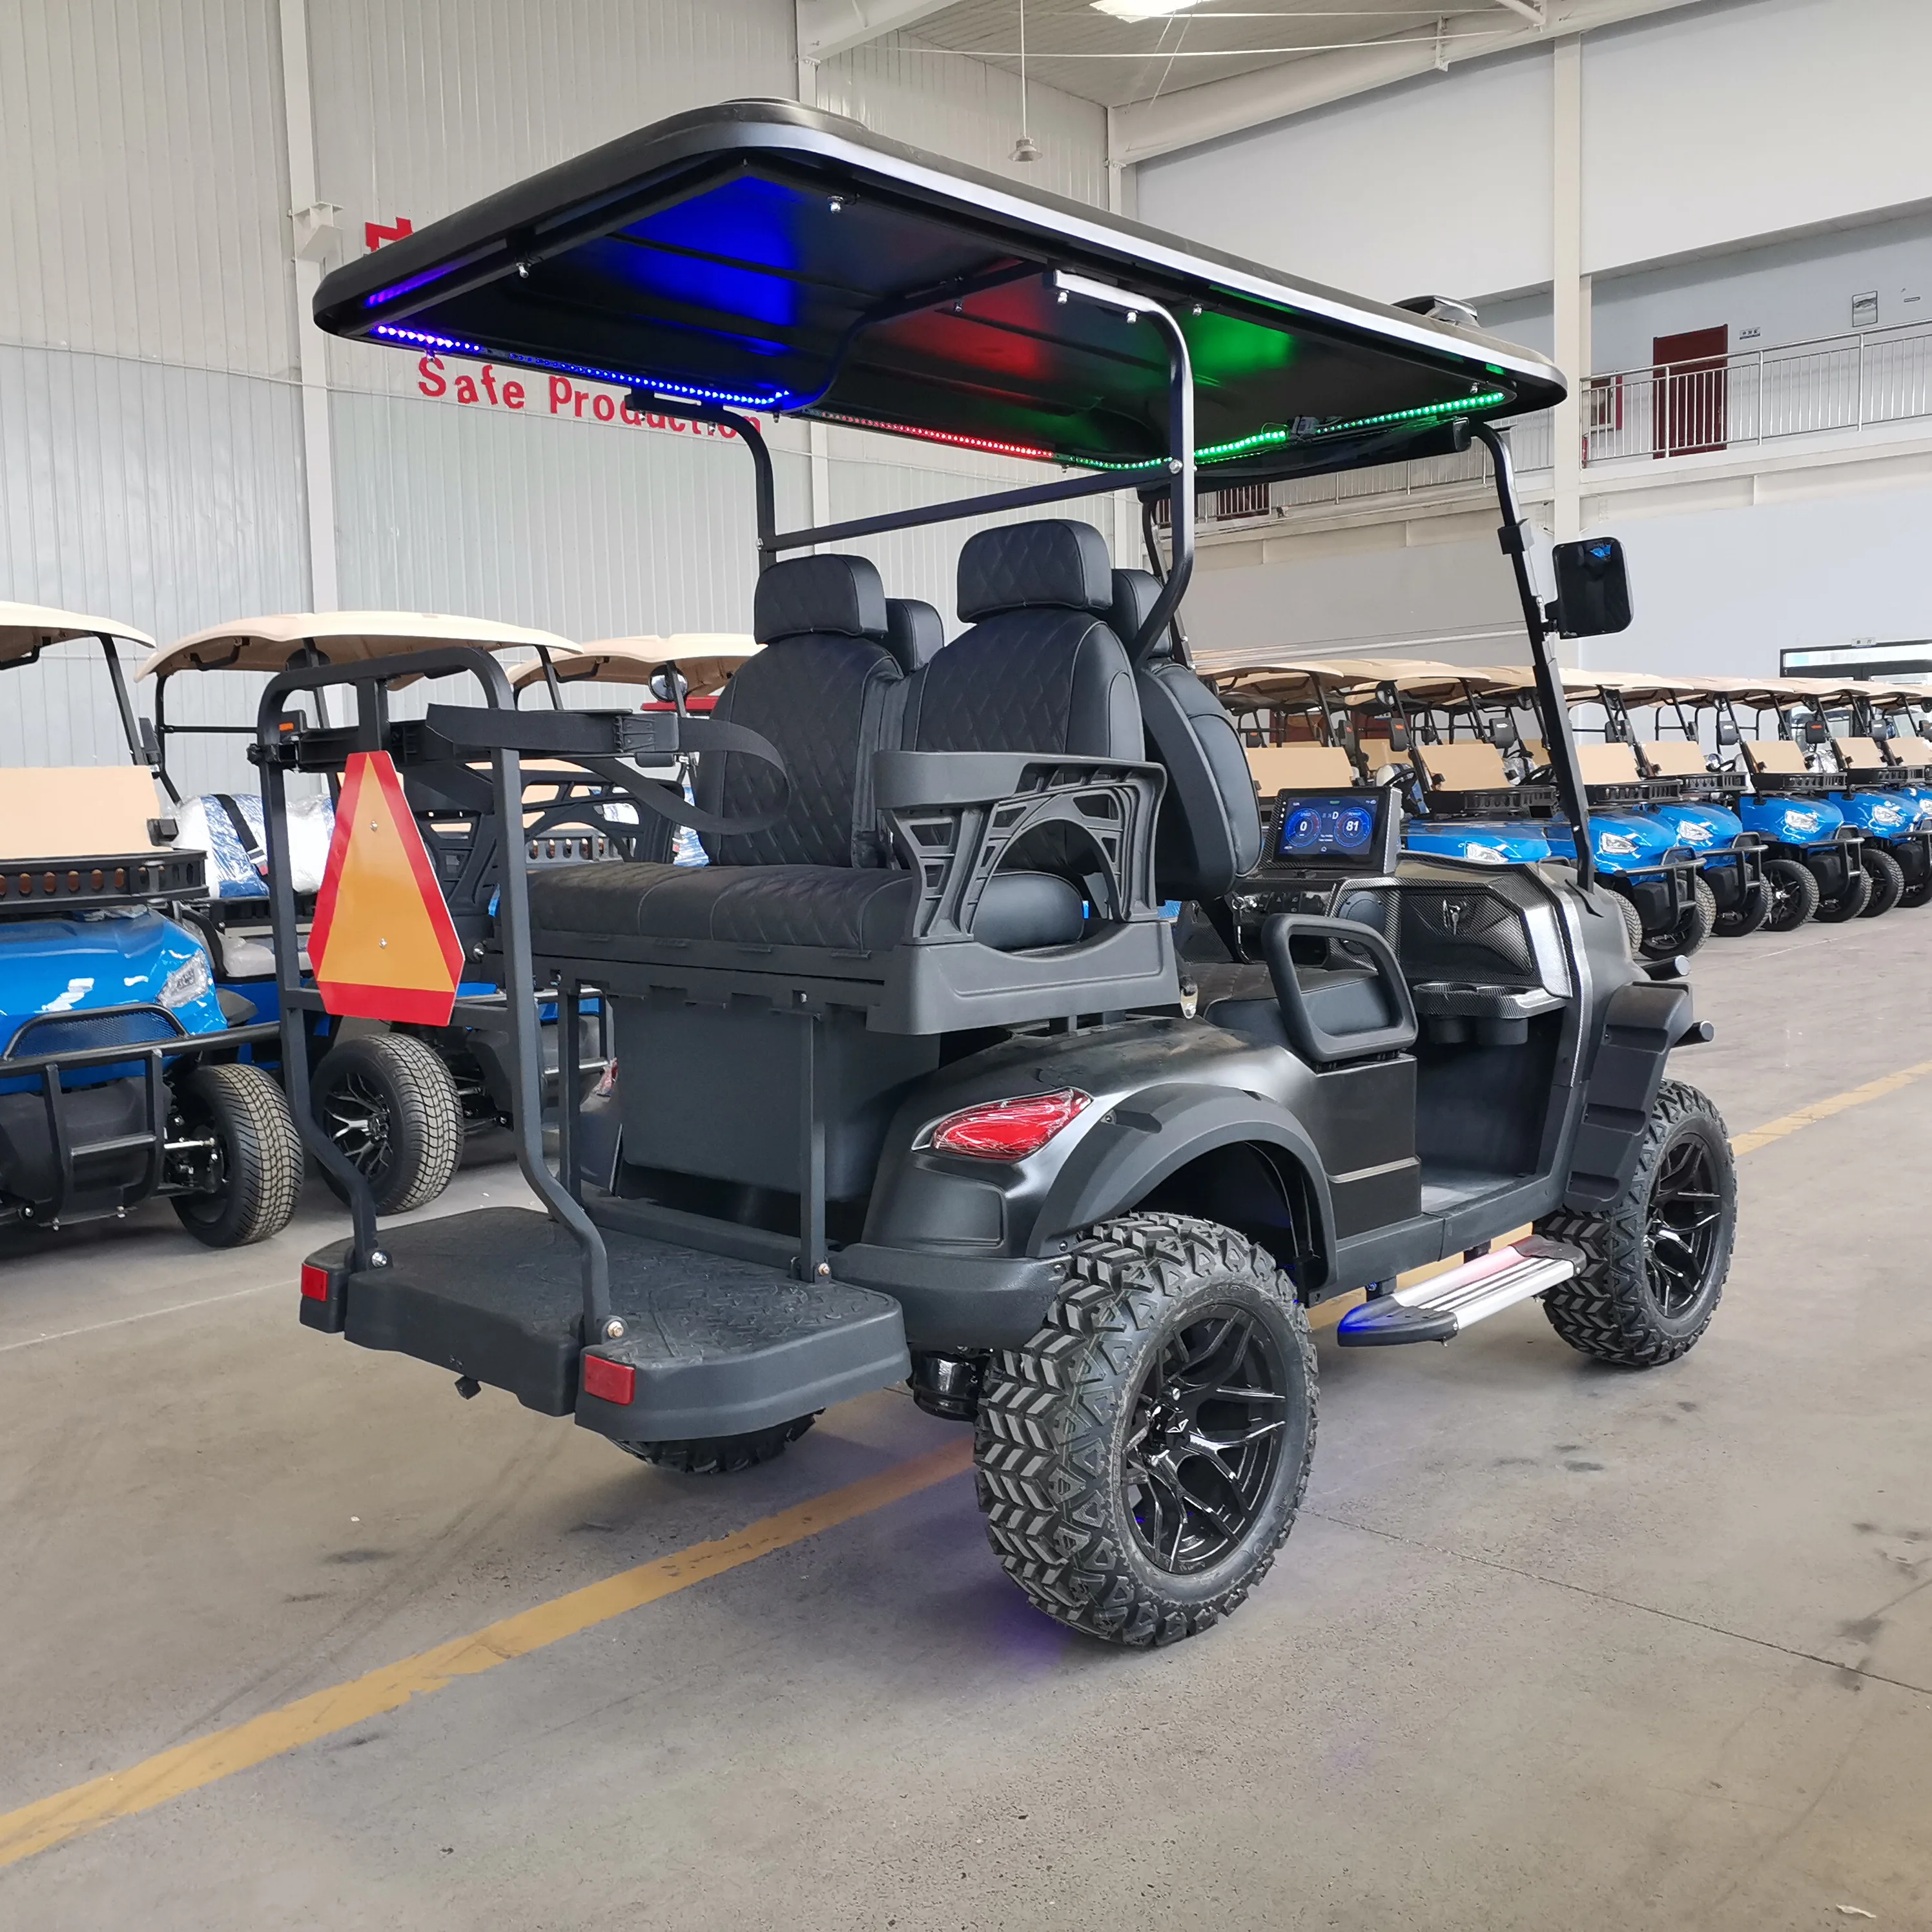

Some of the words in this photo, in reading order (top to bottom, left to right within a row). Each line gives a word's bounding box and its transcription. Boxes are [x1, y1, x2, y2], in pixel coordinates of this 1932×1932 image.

[418, 356, 525, 409] Safe
[1300, 821, 1308, 832] 0
[1346, 821, 1359, 832] 81
